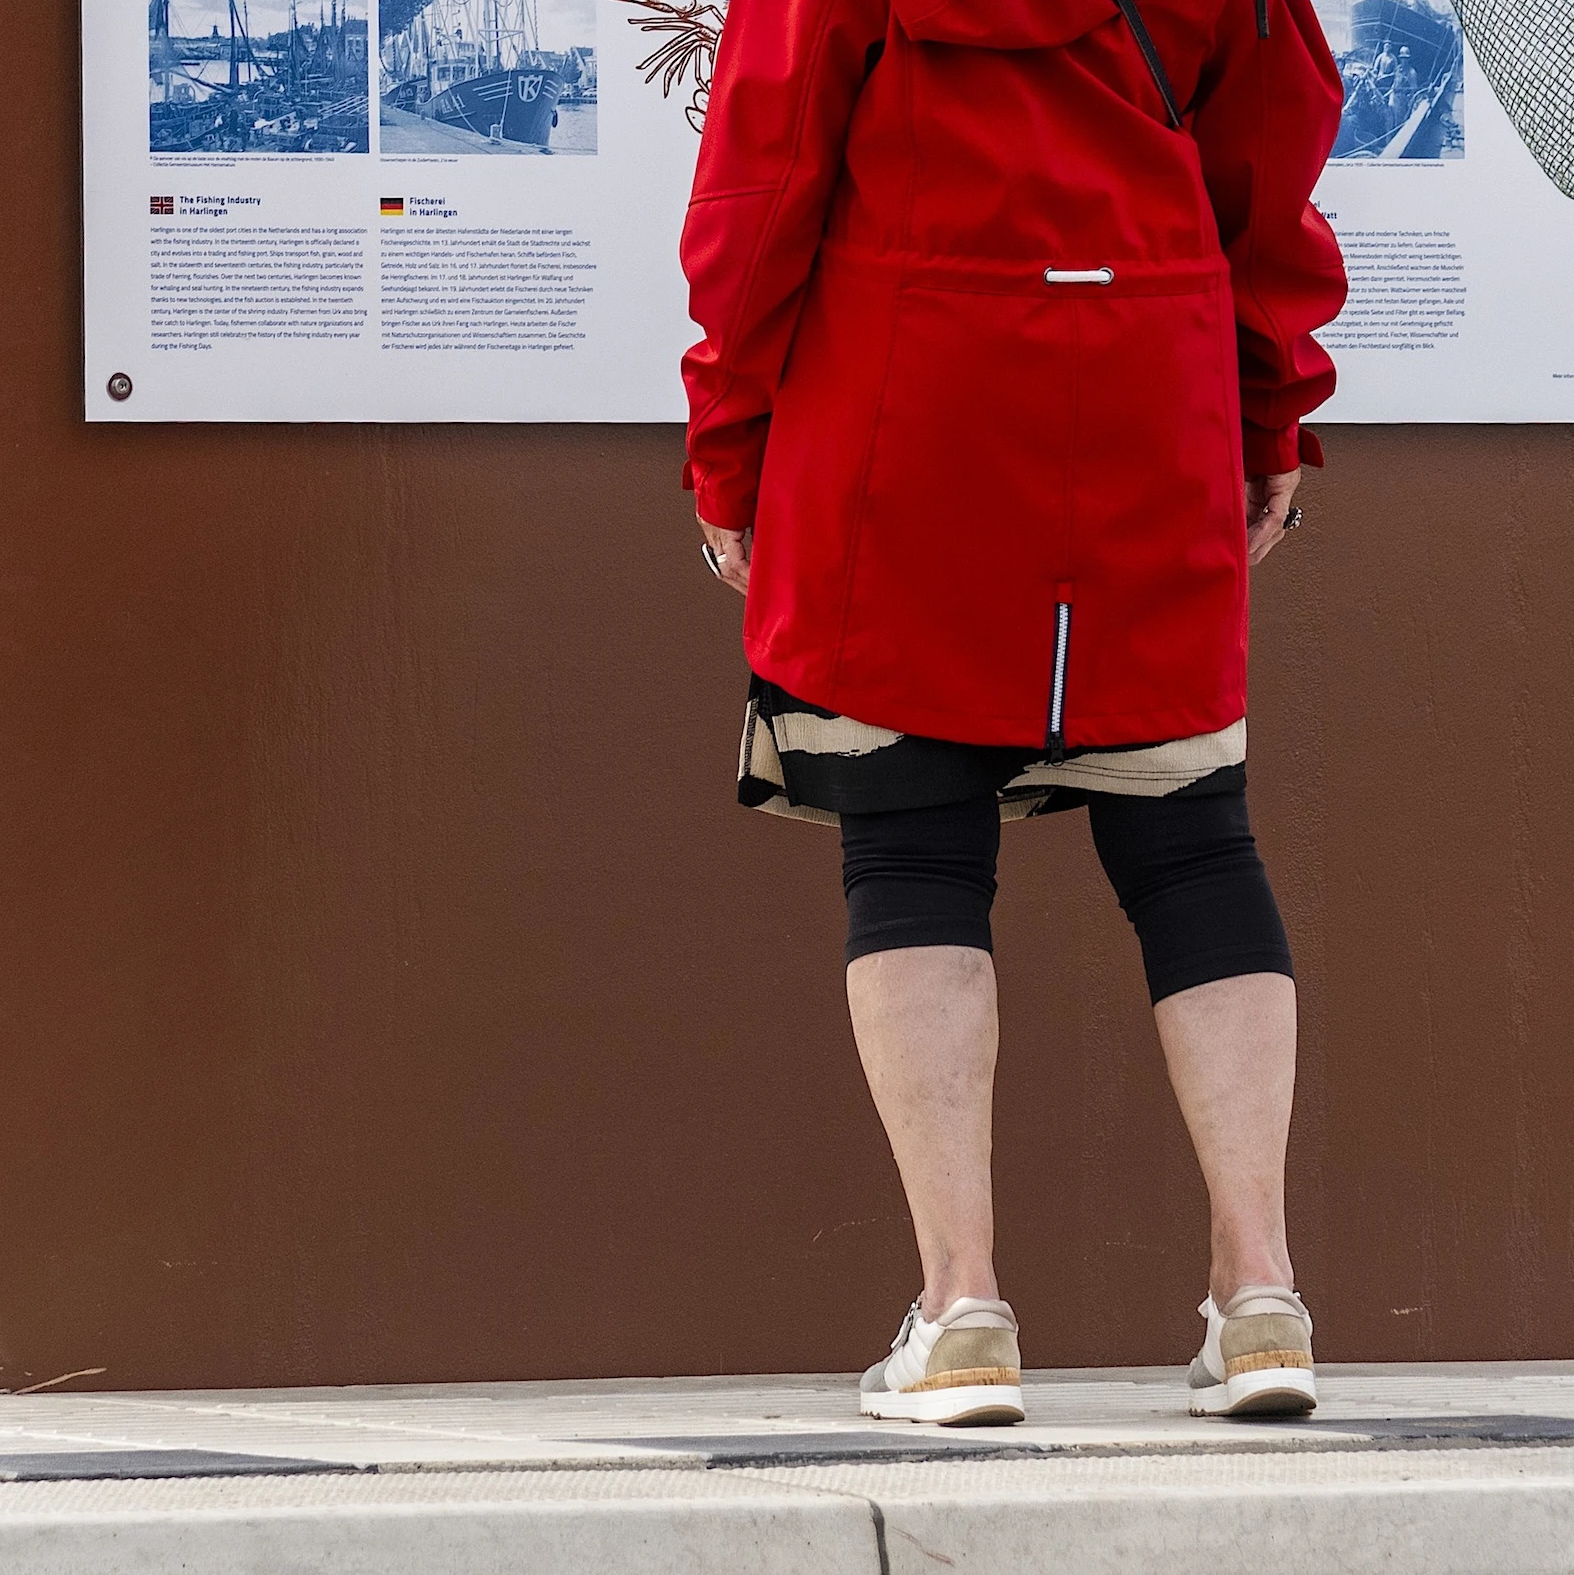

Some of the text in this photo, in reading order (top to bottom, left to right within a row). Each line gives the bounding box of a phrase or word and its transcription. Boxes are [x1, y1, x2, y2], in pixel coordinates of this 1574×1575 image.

[179, 195, 261, 206] The Fishing Industry
[408, 197, 446, 205] Fischerei
[189, 207, 228, 217] Harlingen
[409, 208, 458, 218] in Harlingen
